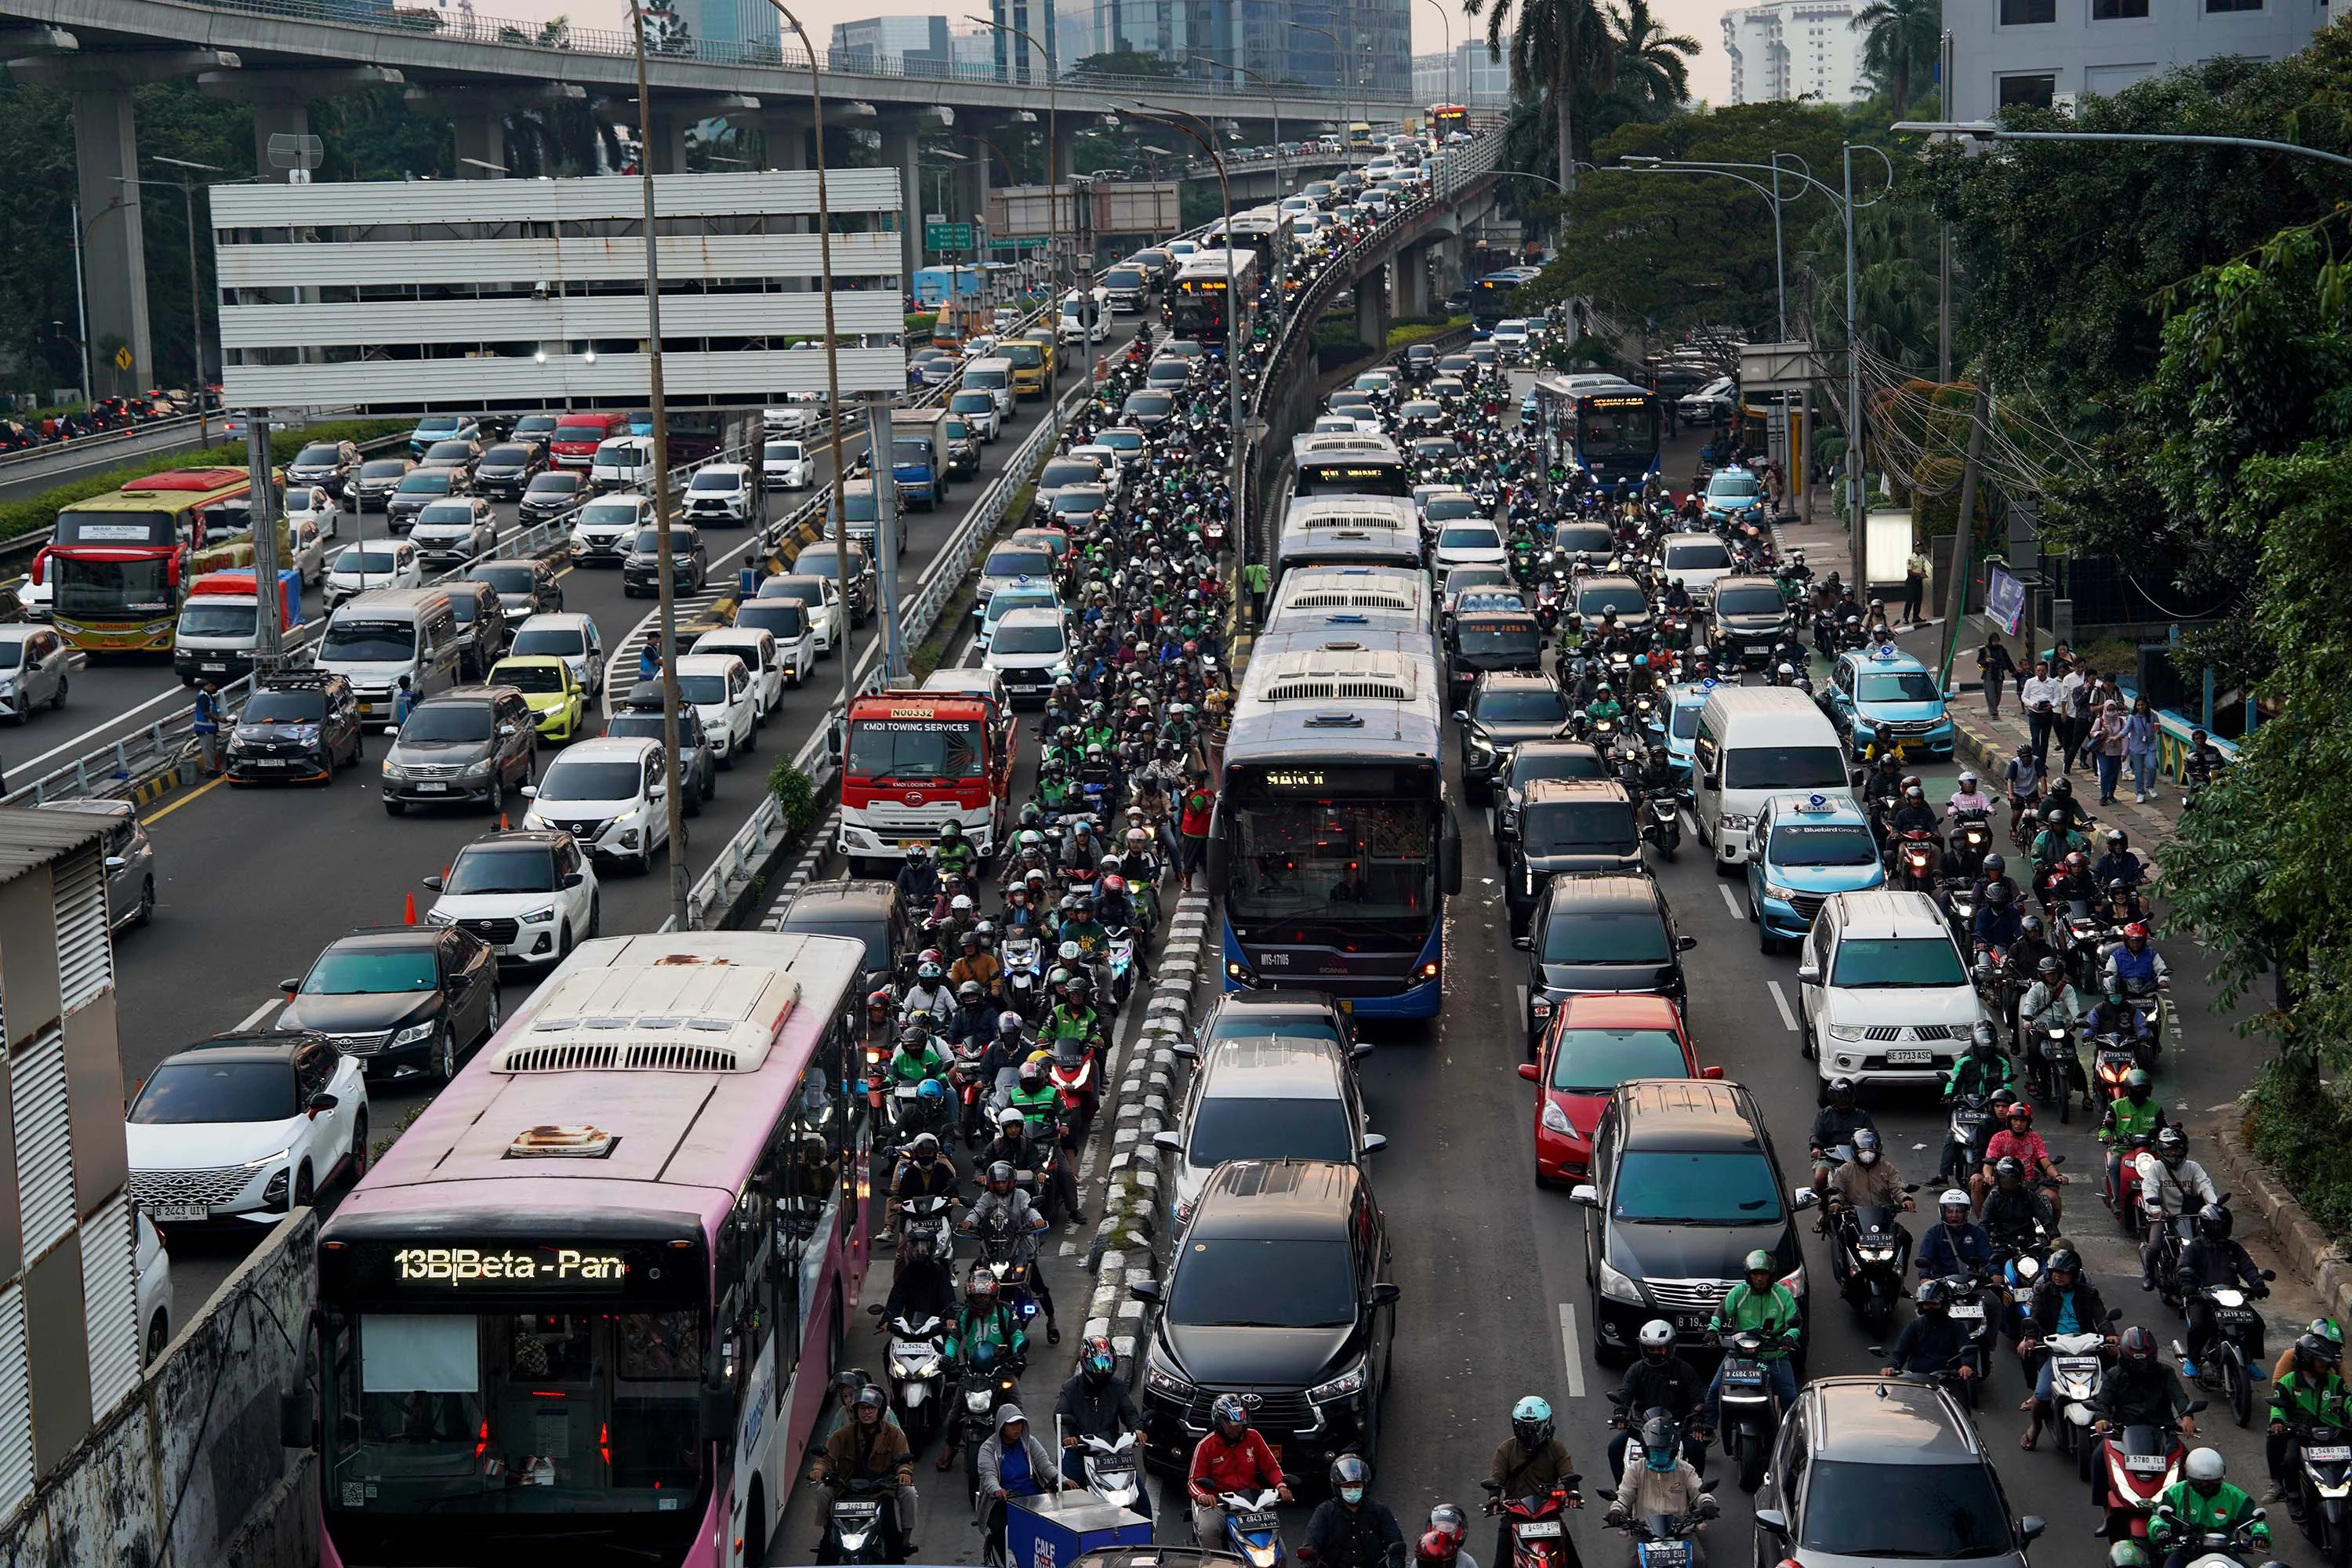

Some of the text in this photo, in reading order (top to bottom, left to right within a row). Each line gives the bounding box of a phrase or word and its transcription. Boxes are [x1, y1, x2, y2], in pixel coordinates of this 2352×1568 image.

[1261, 953, 1289, 966] MYS-17105
[1679, 1318, 1683, 1327] B
[1653, 1551, 1671, 1559] 3709
